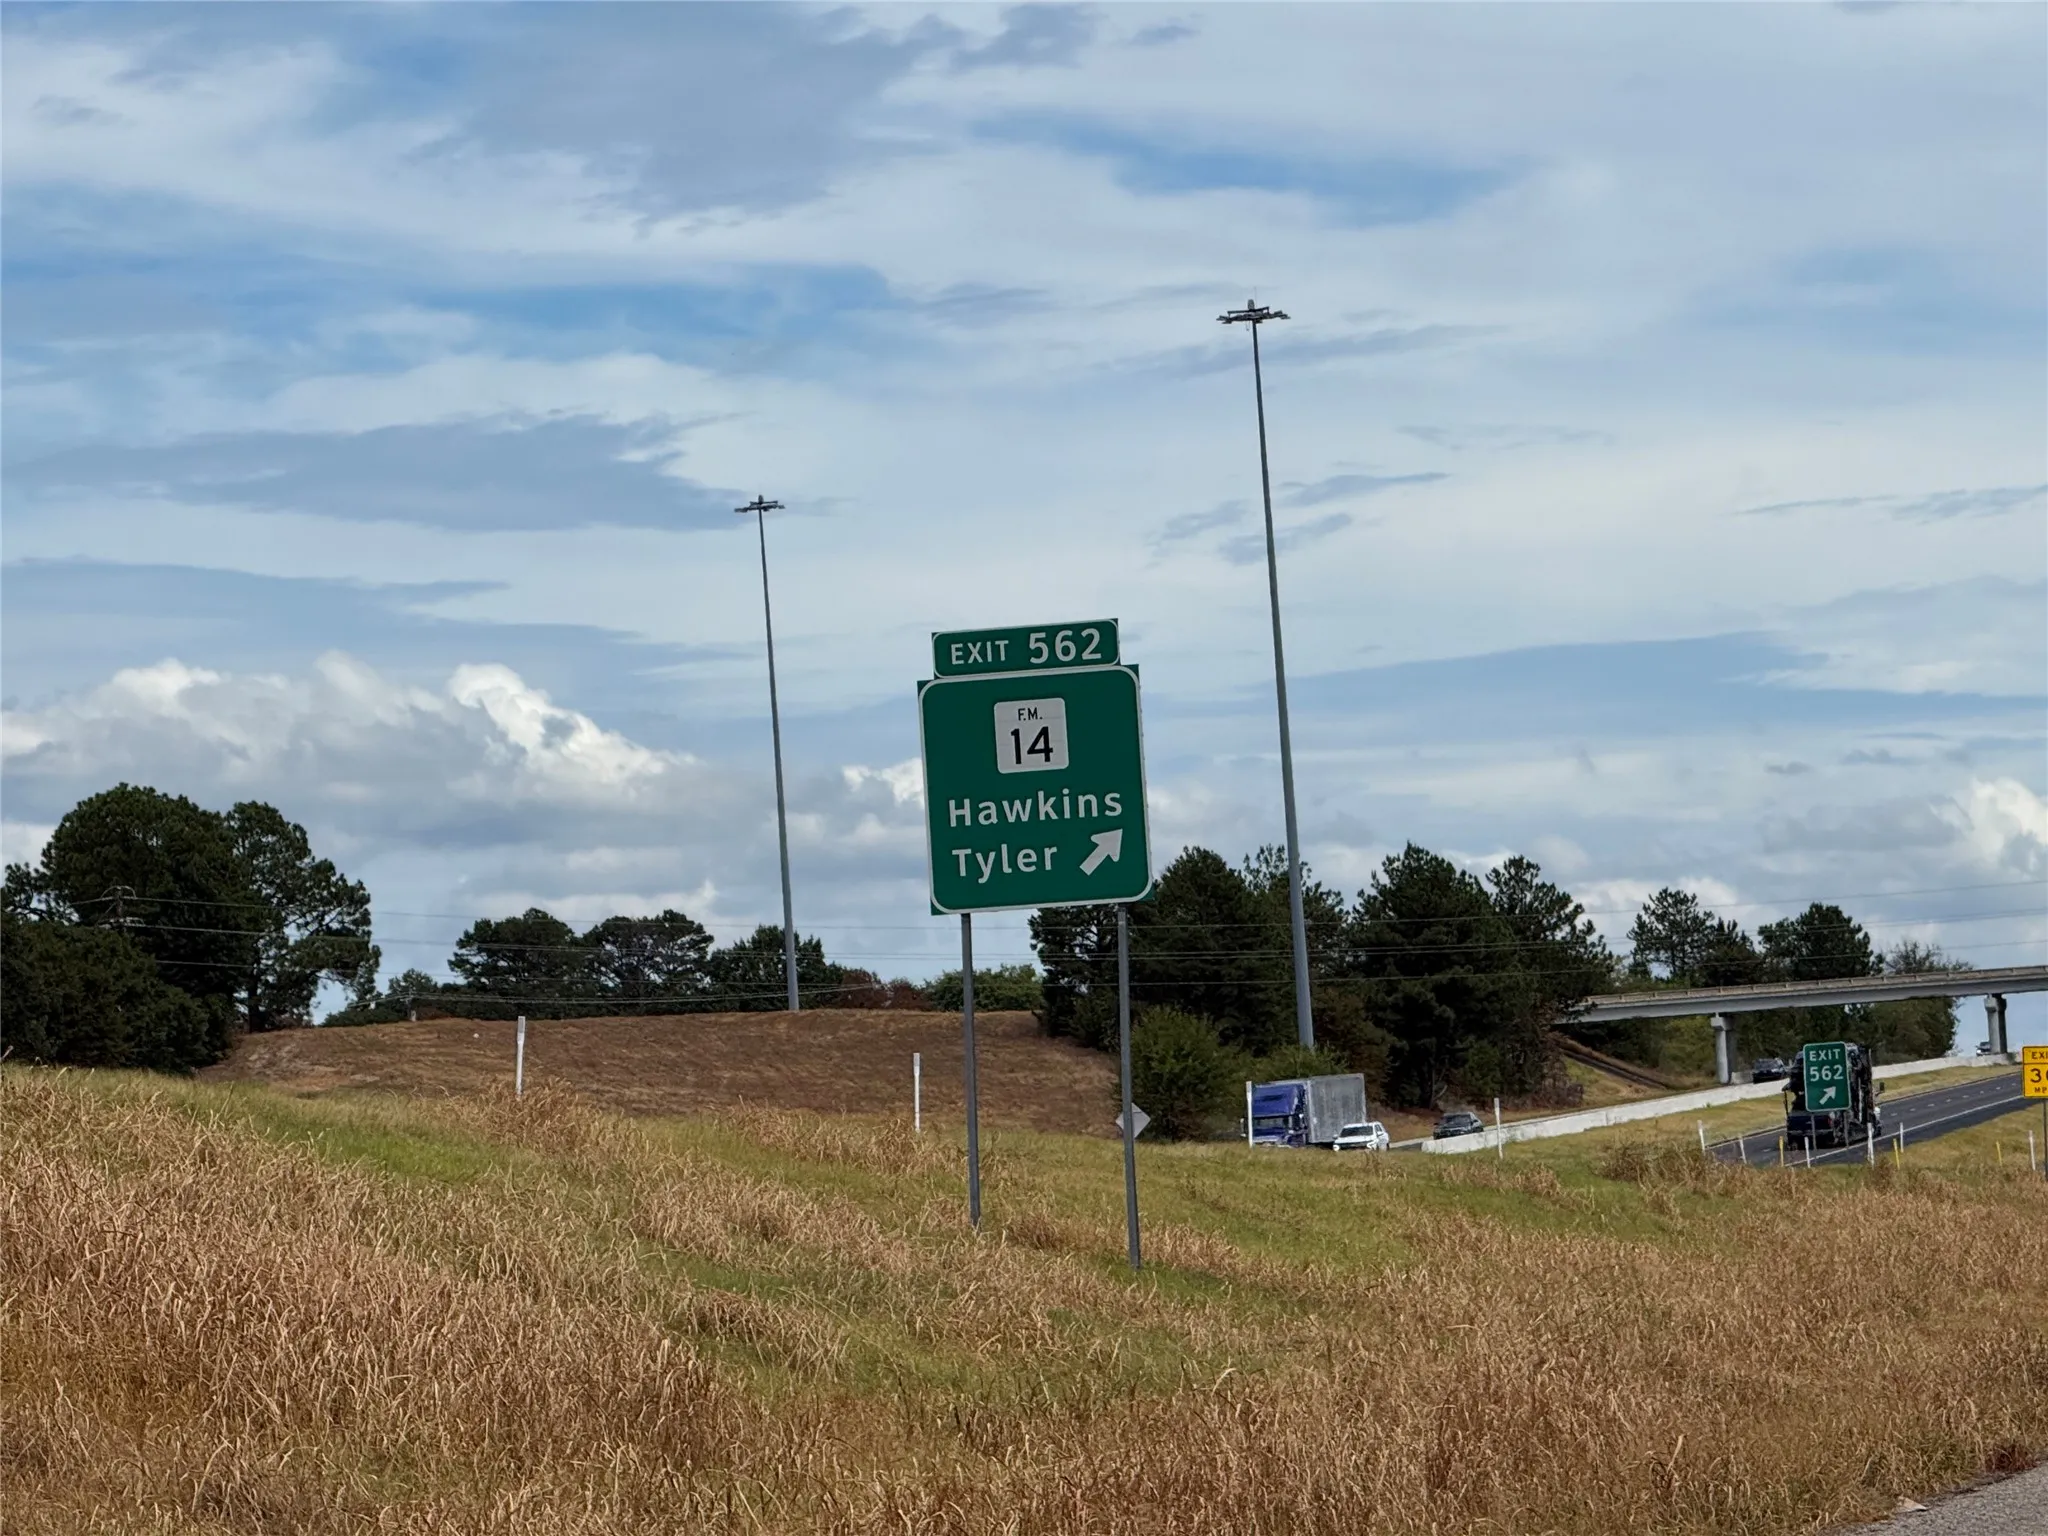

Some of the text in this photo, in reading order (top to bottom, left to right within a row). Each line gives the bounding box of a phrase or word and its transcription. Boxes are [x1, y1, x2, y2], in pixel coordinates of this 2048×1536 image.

[951, 627, 1102, 665] EXIT 562
[1017, 707, 1043, 721] F.M.
[1010, 726, 1054, 765] 14
[948, 788, 1123, 828] Hawkins
[952, 843, 1058, 884] Tyler
[1809, 1048, 1841, 1061] EXIT
[1809, 1064, 1844, 1082] 562
